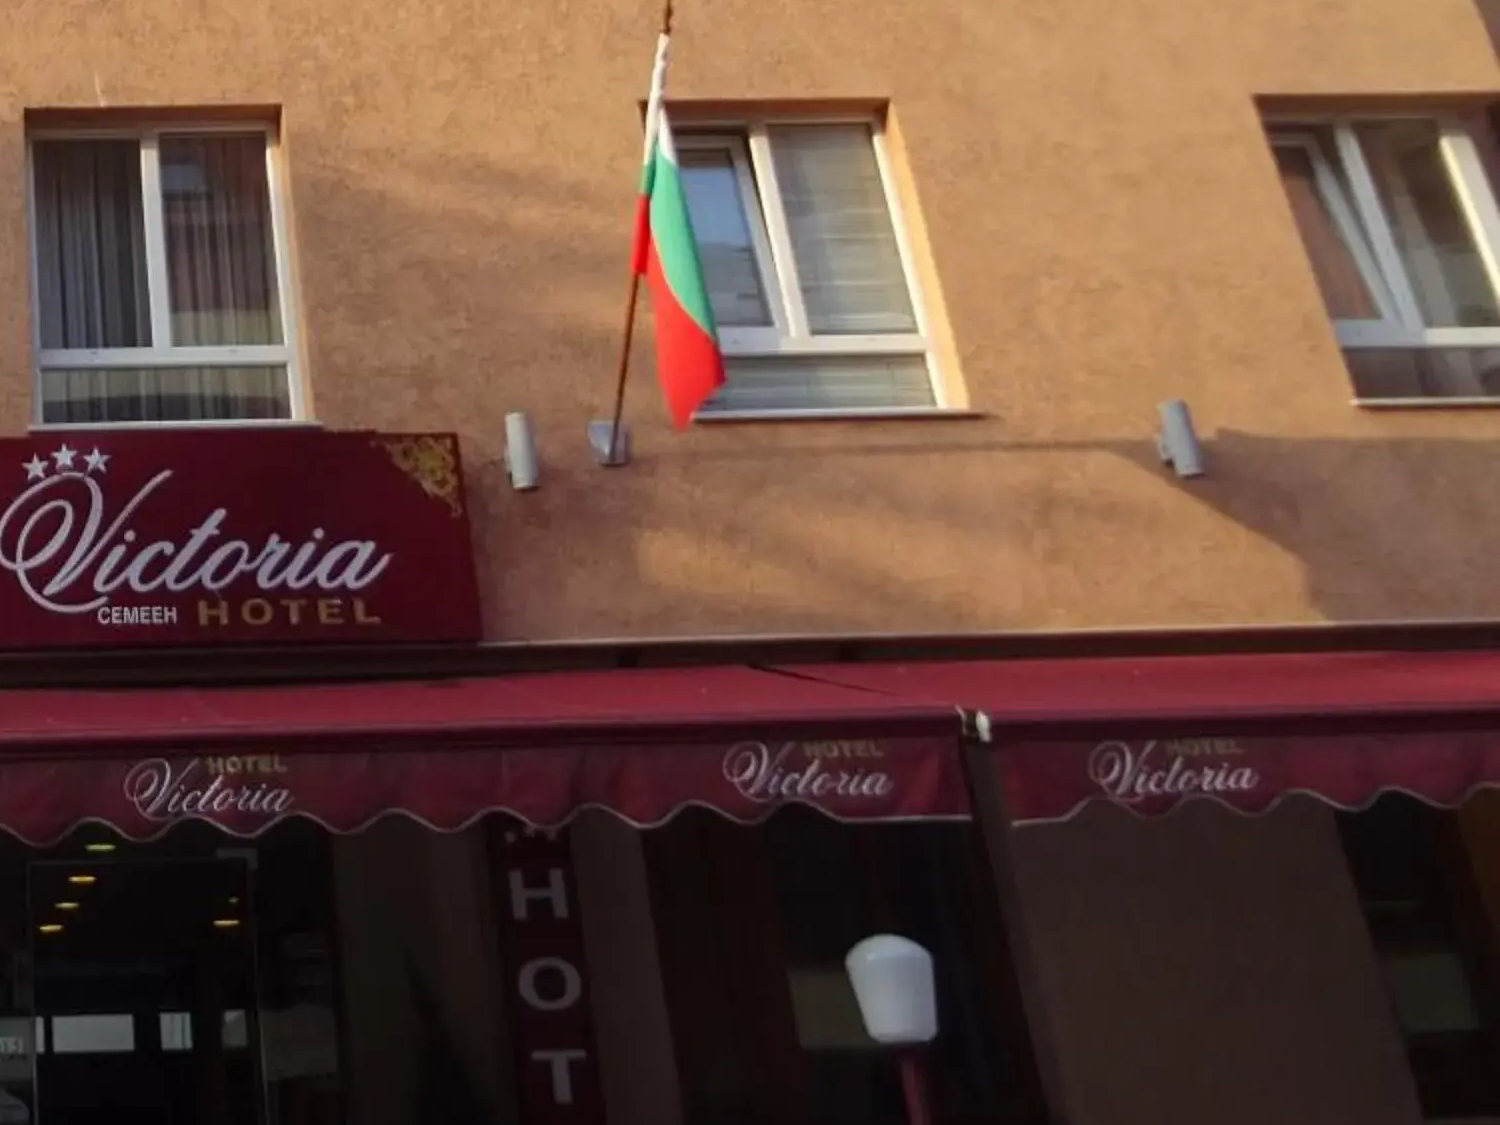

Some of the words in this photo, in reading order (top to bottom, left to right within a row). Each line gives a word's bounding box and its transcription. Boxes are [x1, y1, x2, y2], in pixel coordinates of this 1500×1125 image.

[97, 606, 177, 625] СЕМЕЕН
[198, 598, 382, 626] HOTEL
[803, 739, 885, 760] HOTEL
[1165, 739, 1244, 757] HOTEL
[205, 756, 288, 775] HOTEL
[723, 741, 892, 800] Victoria
[1089, 740, 1259, 799] Victoria
[124, 758, 294, 822] Victoria
